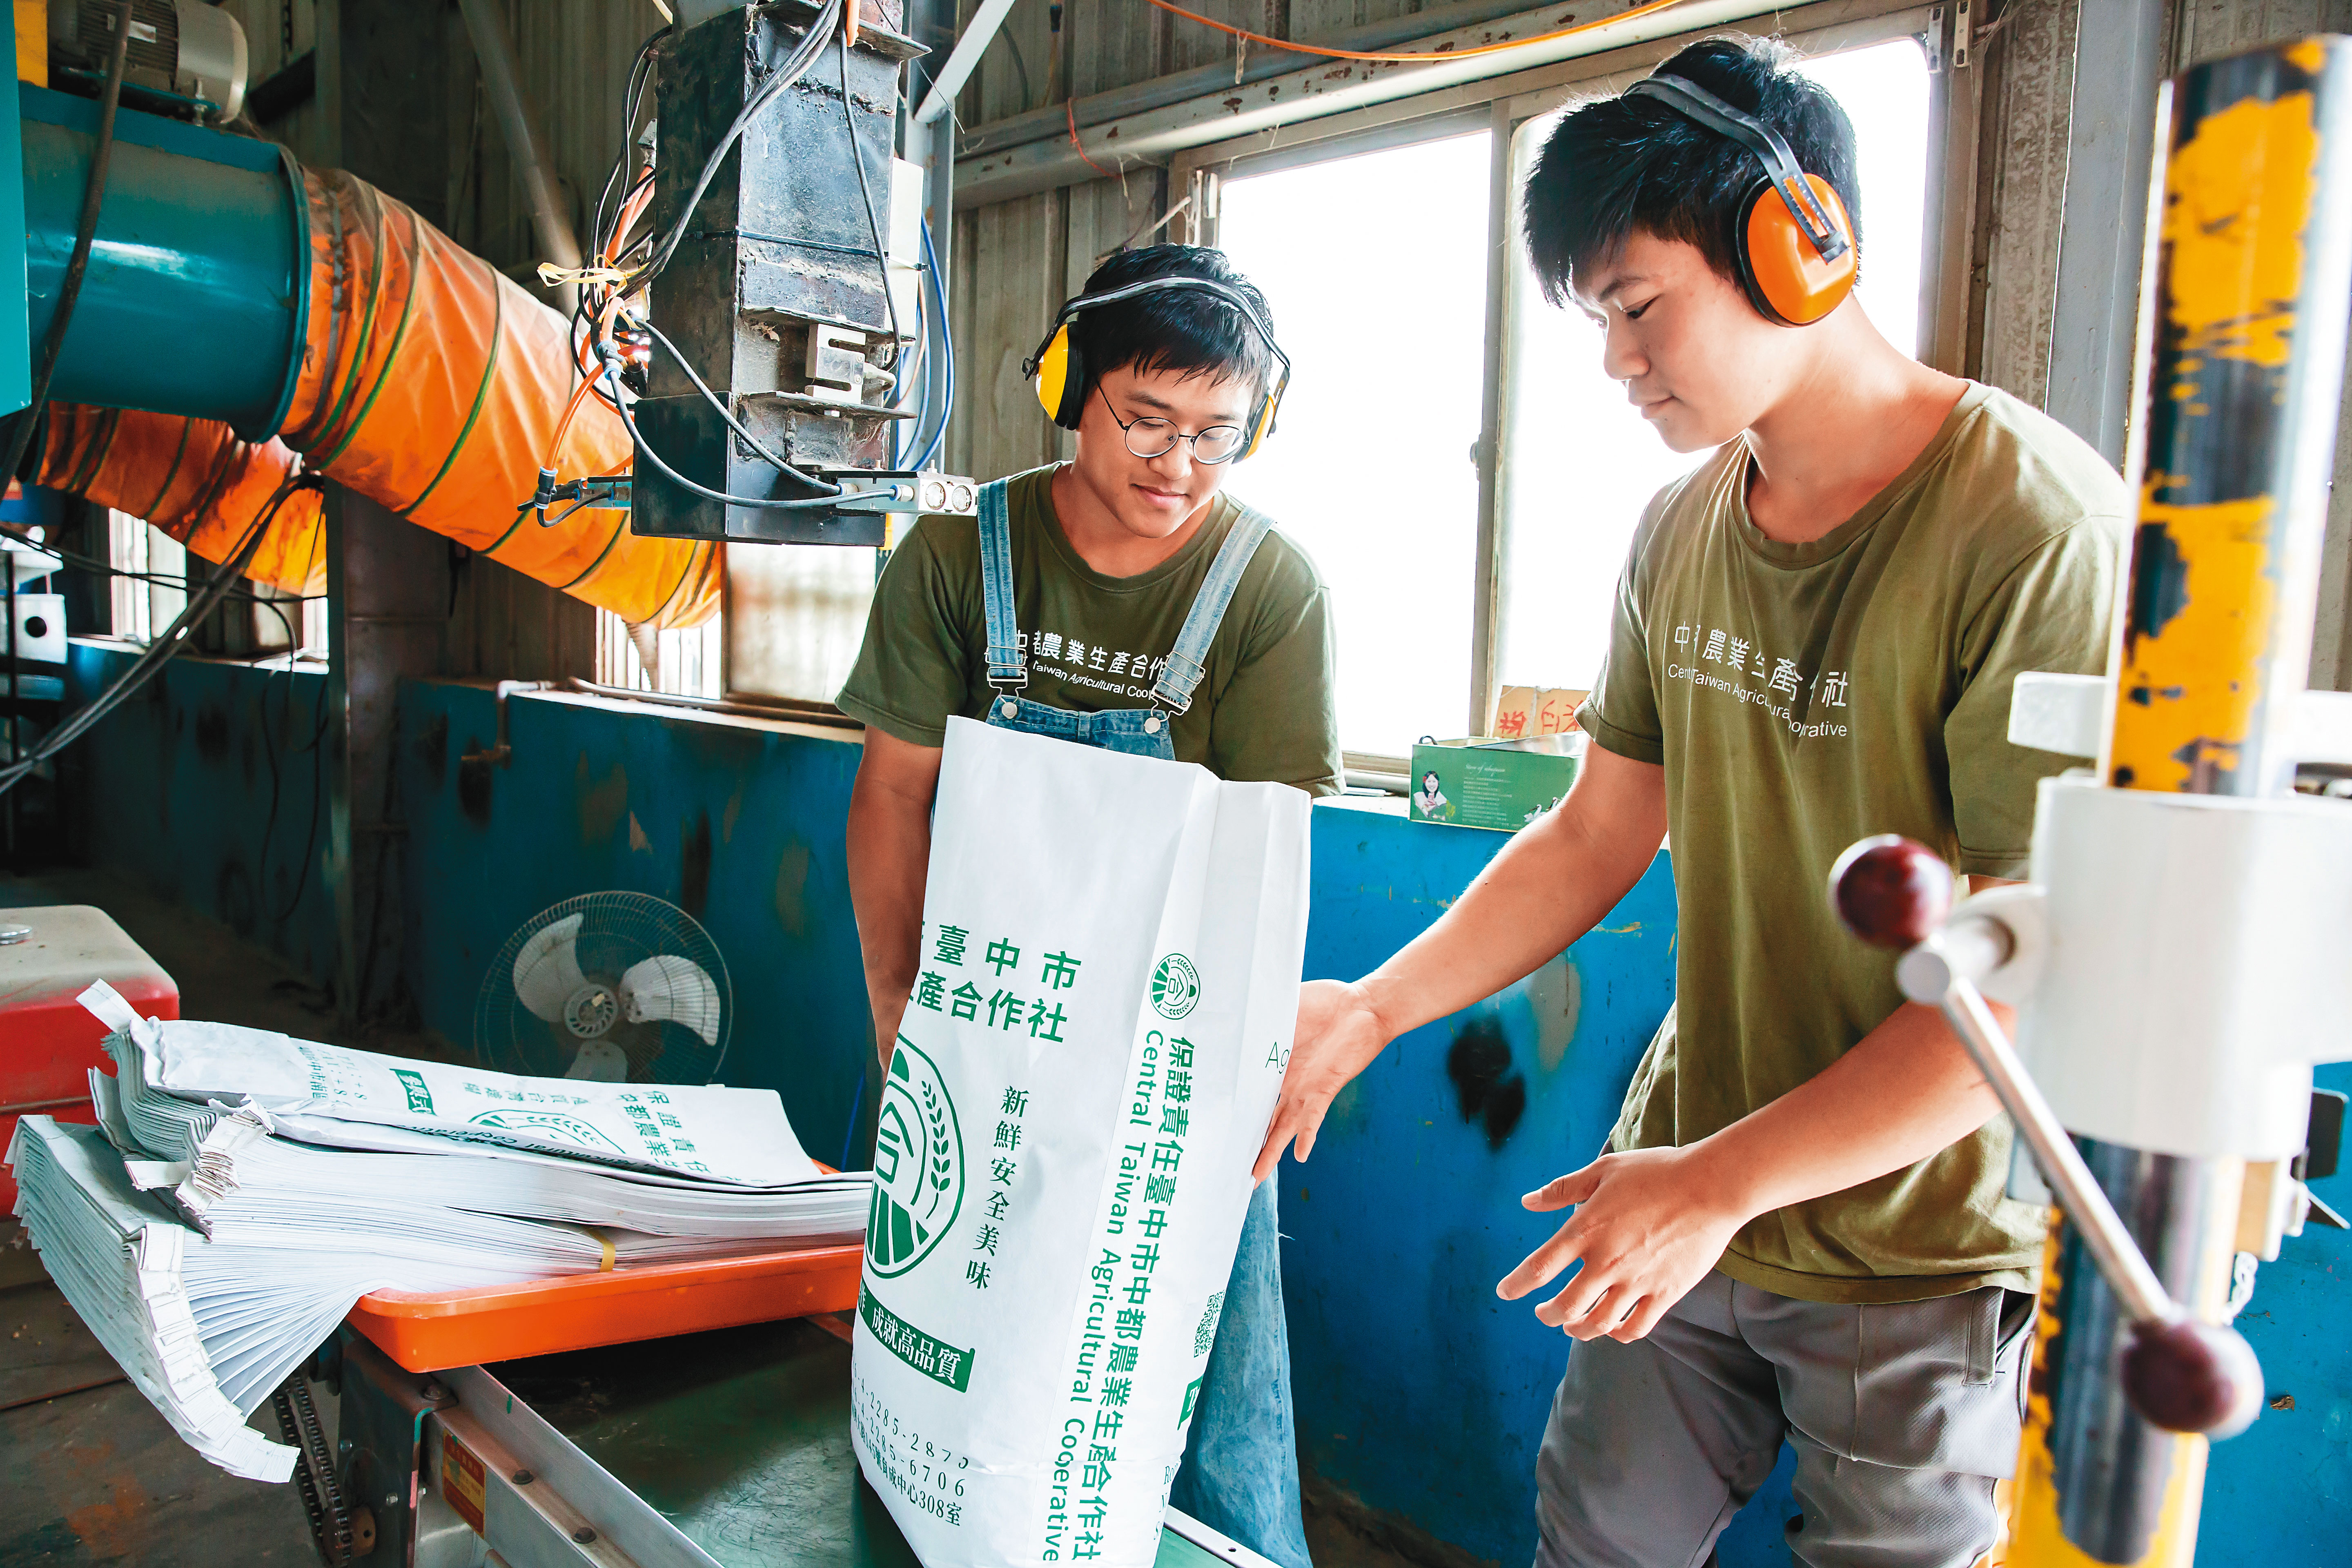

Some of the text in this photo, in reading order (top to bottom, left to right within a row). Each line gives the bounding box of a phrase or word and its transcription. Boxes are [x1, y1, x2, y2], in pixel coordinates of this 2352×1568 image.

[1033, 660, 1067, 681] Taiwan
[1068, 673, 1124, 695] Agricultural
[1691, 669, 1731, 693] Taiwan
[922, 920, 1082, 991] 臺中市
[909, 970, 1068, 1043] 產合作社
[1130, 1030, 1165, 1127] Central
[966, 1085, 1029, 1290] 新鮮安全美味
[1107, 1142, 1147, 1235] Taiwan
[871, 1306, 961, 1385] 成就高品質
[1070, 1248, 1122, 1403] Agricultural
